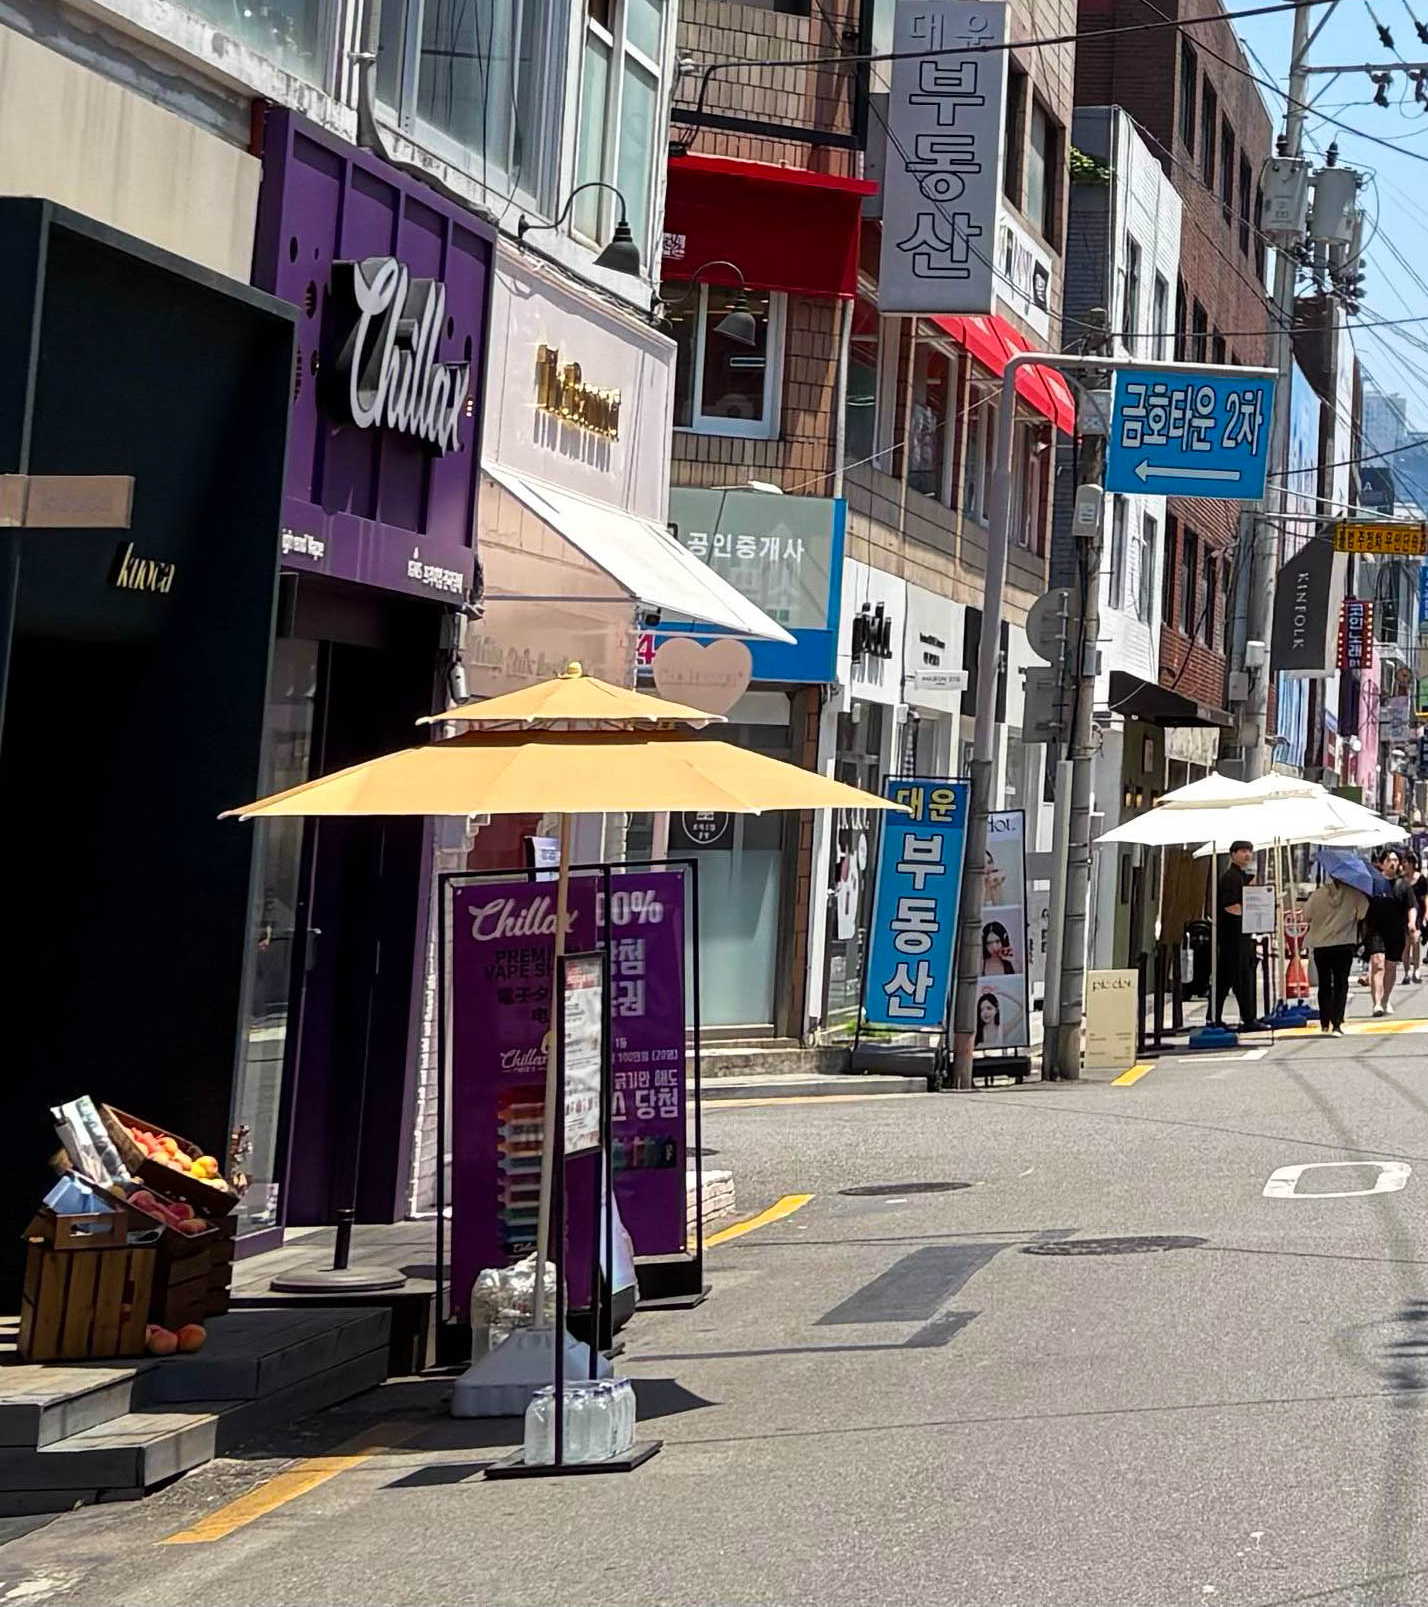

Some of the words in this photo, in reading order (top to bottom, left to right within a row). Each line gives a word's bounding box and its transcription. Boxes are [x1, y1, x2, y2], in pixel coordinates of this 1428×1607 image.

[909, 12, 996, 53] 대운
[897, 61, 985, 280] 부동산
[353, 257, 471, 454] Chillax
[1121, 382, 1217, 452] 금호타운
[1222, 393, 1263, 455] 2차
[687, 530, 805, 563] 공인중개사
[1291, 572, 1309, 650] KINFOLK
[896, 786, 957, 823] 대운
[884, 833, 945, 1019] 부동산
[495, 947, 557, 964] PREMI
[635, 1087, 679, 1120] 당첨
